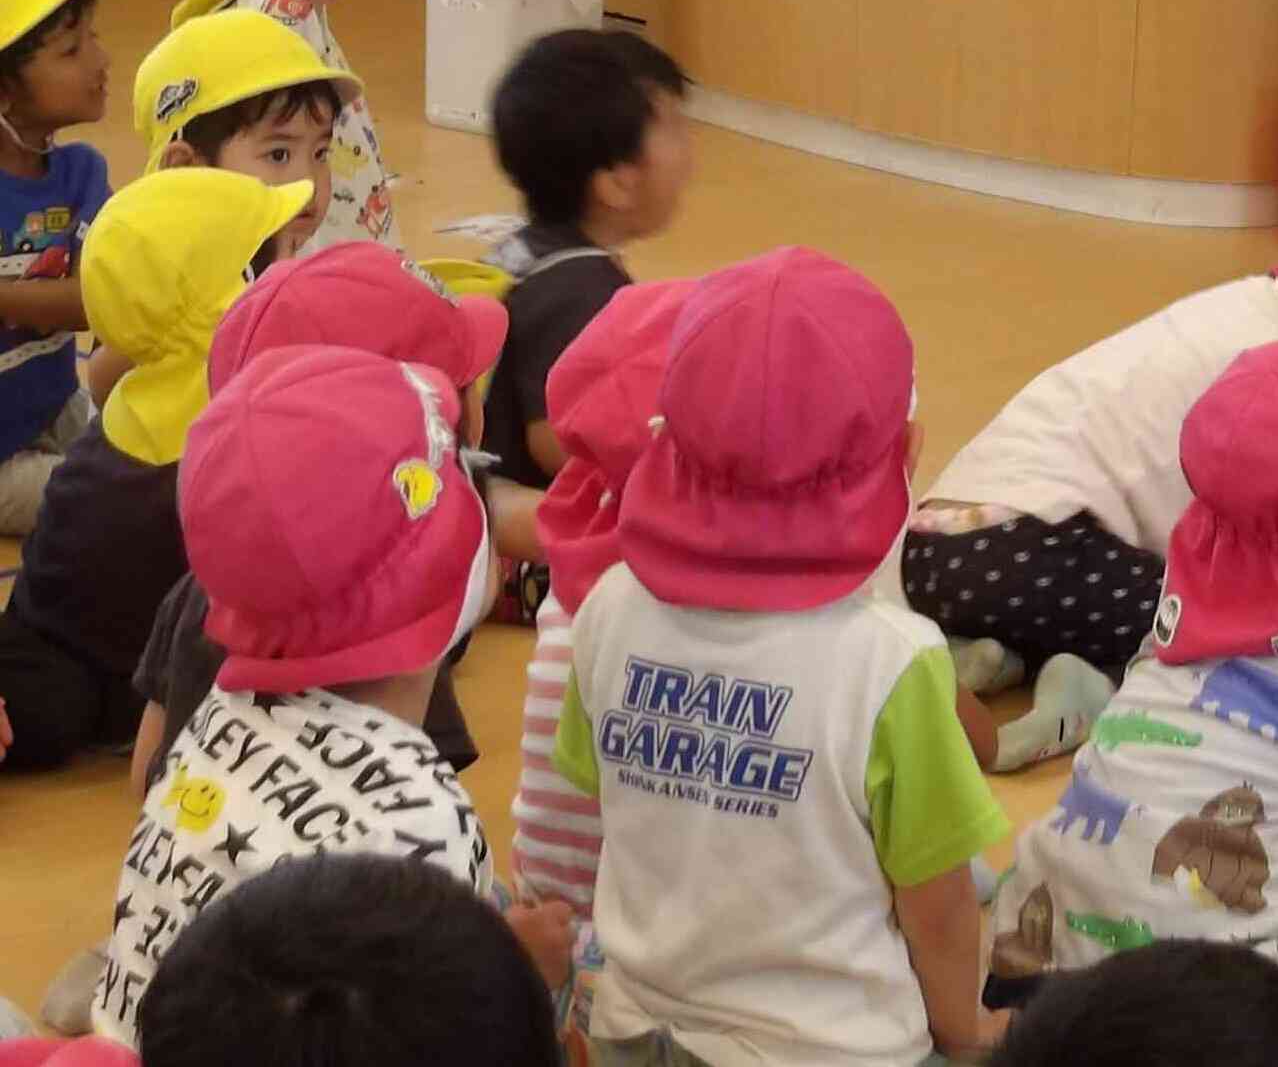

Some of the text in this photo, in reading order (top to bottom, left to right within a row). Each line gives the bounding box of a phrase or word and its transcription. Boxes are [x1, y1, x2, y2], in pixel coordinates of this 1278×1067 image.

[623, 655, 793, 739] TRAIN
[599, 709, 814, 801] GARAGE
[714, 794, 779, 818] SERIES
